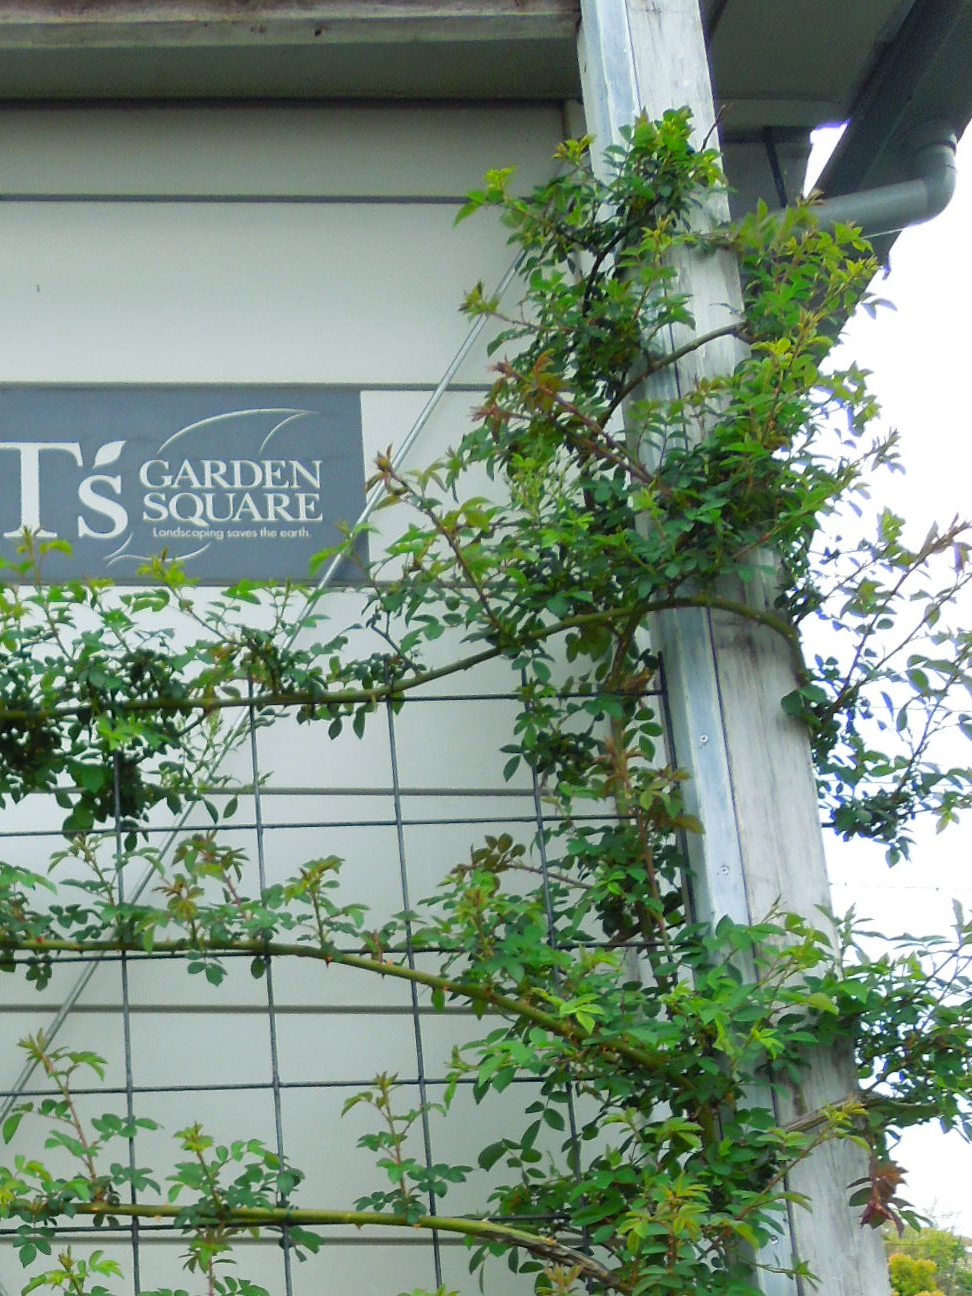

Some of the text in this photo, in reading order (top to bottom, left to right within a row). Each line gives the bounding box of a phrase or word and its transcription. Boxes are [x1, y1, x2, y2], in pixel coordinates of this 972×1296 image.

[139, 459, 323, 489] GARDEN
[142, 492, 324, 526] SQUARE
[152, 527, 224, 541] Landscaping
[227, 529, 257, 539] saves
[259, 527, 278, 539] the
